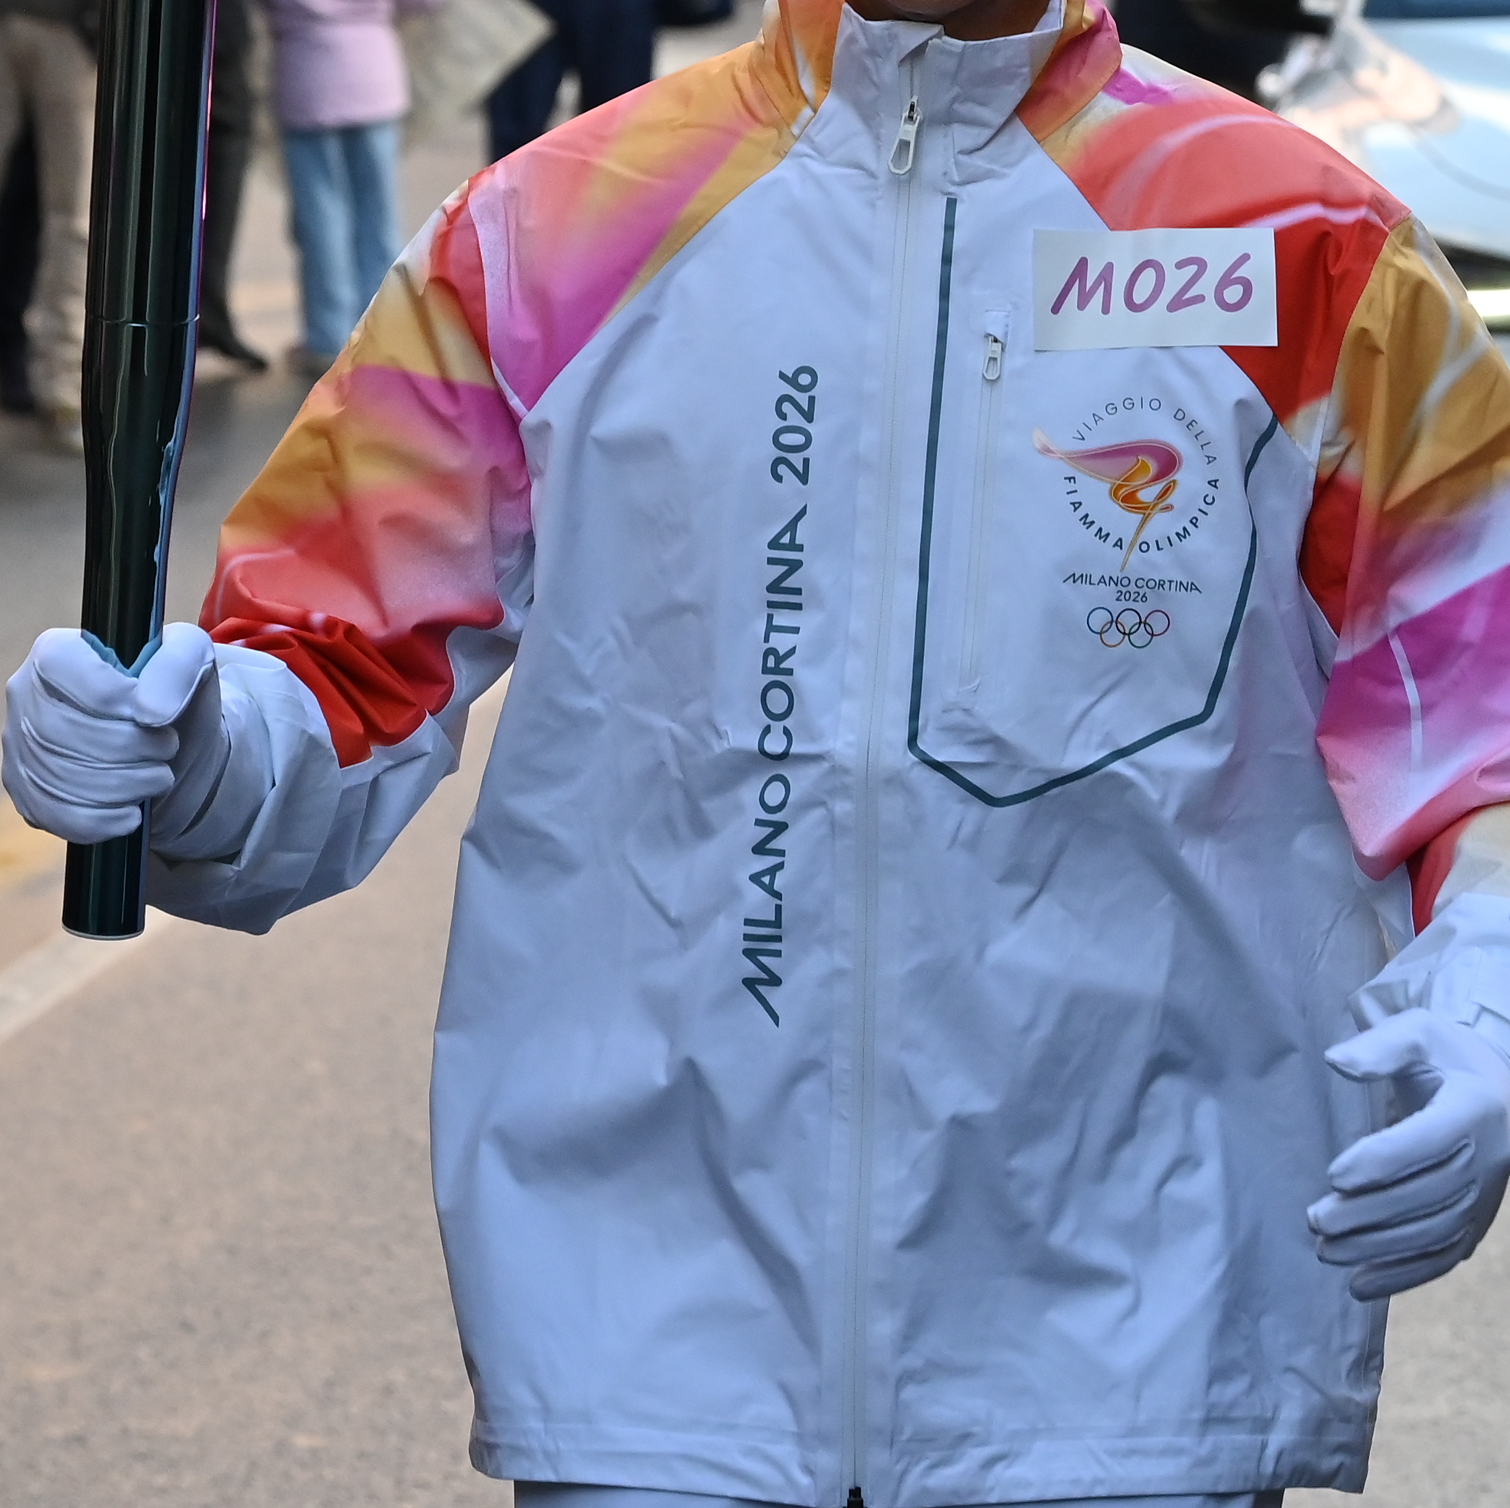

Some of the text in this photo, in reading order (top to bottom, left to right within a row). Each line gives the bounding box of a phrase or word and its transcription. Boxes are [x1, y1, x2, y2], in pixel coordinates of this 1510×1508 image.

[1071, 396, 1218, 466] VIAGGIO DELLA
[1063, 475, 1220, 554] FIAMMA OLIMPICA
[1062, 572, 1203, 595] MILANO CORTINA
[1114, 589, 1149, 603] 2026
[741, 365, 819, 1029] MILANO CORTINA 2026
